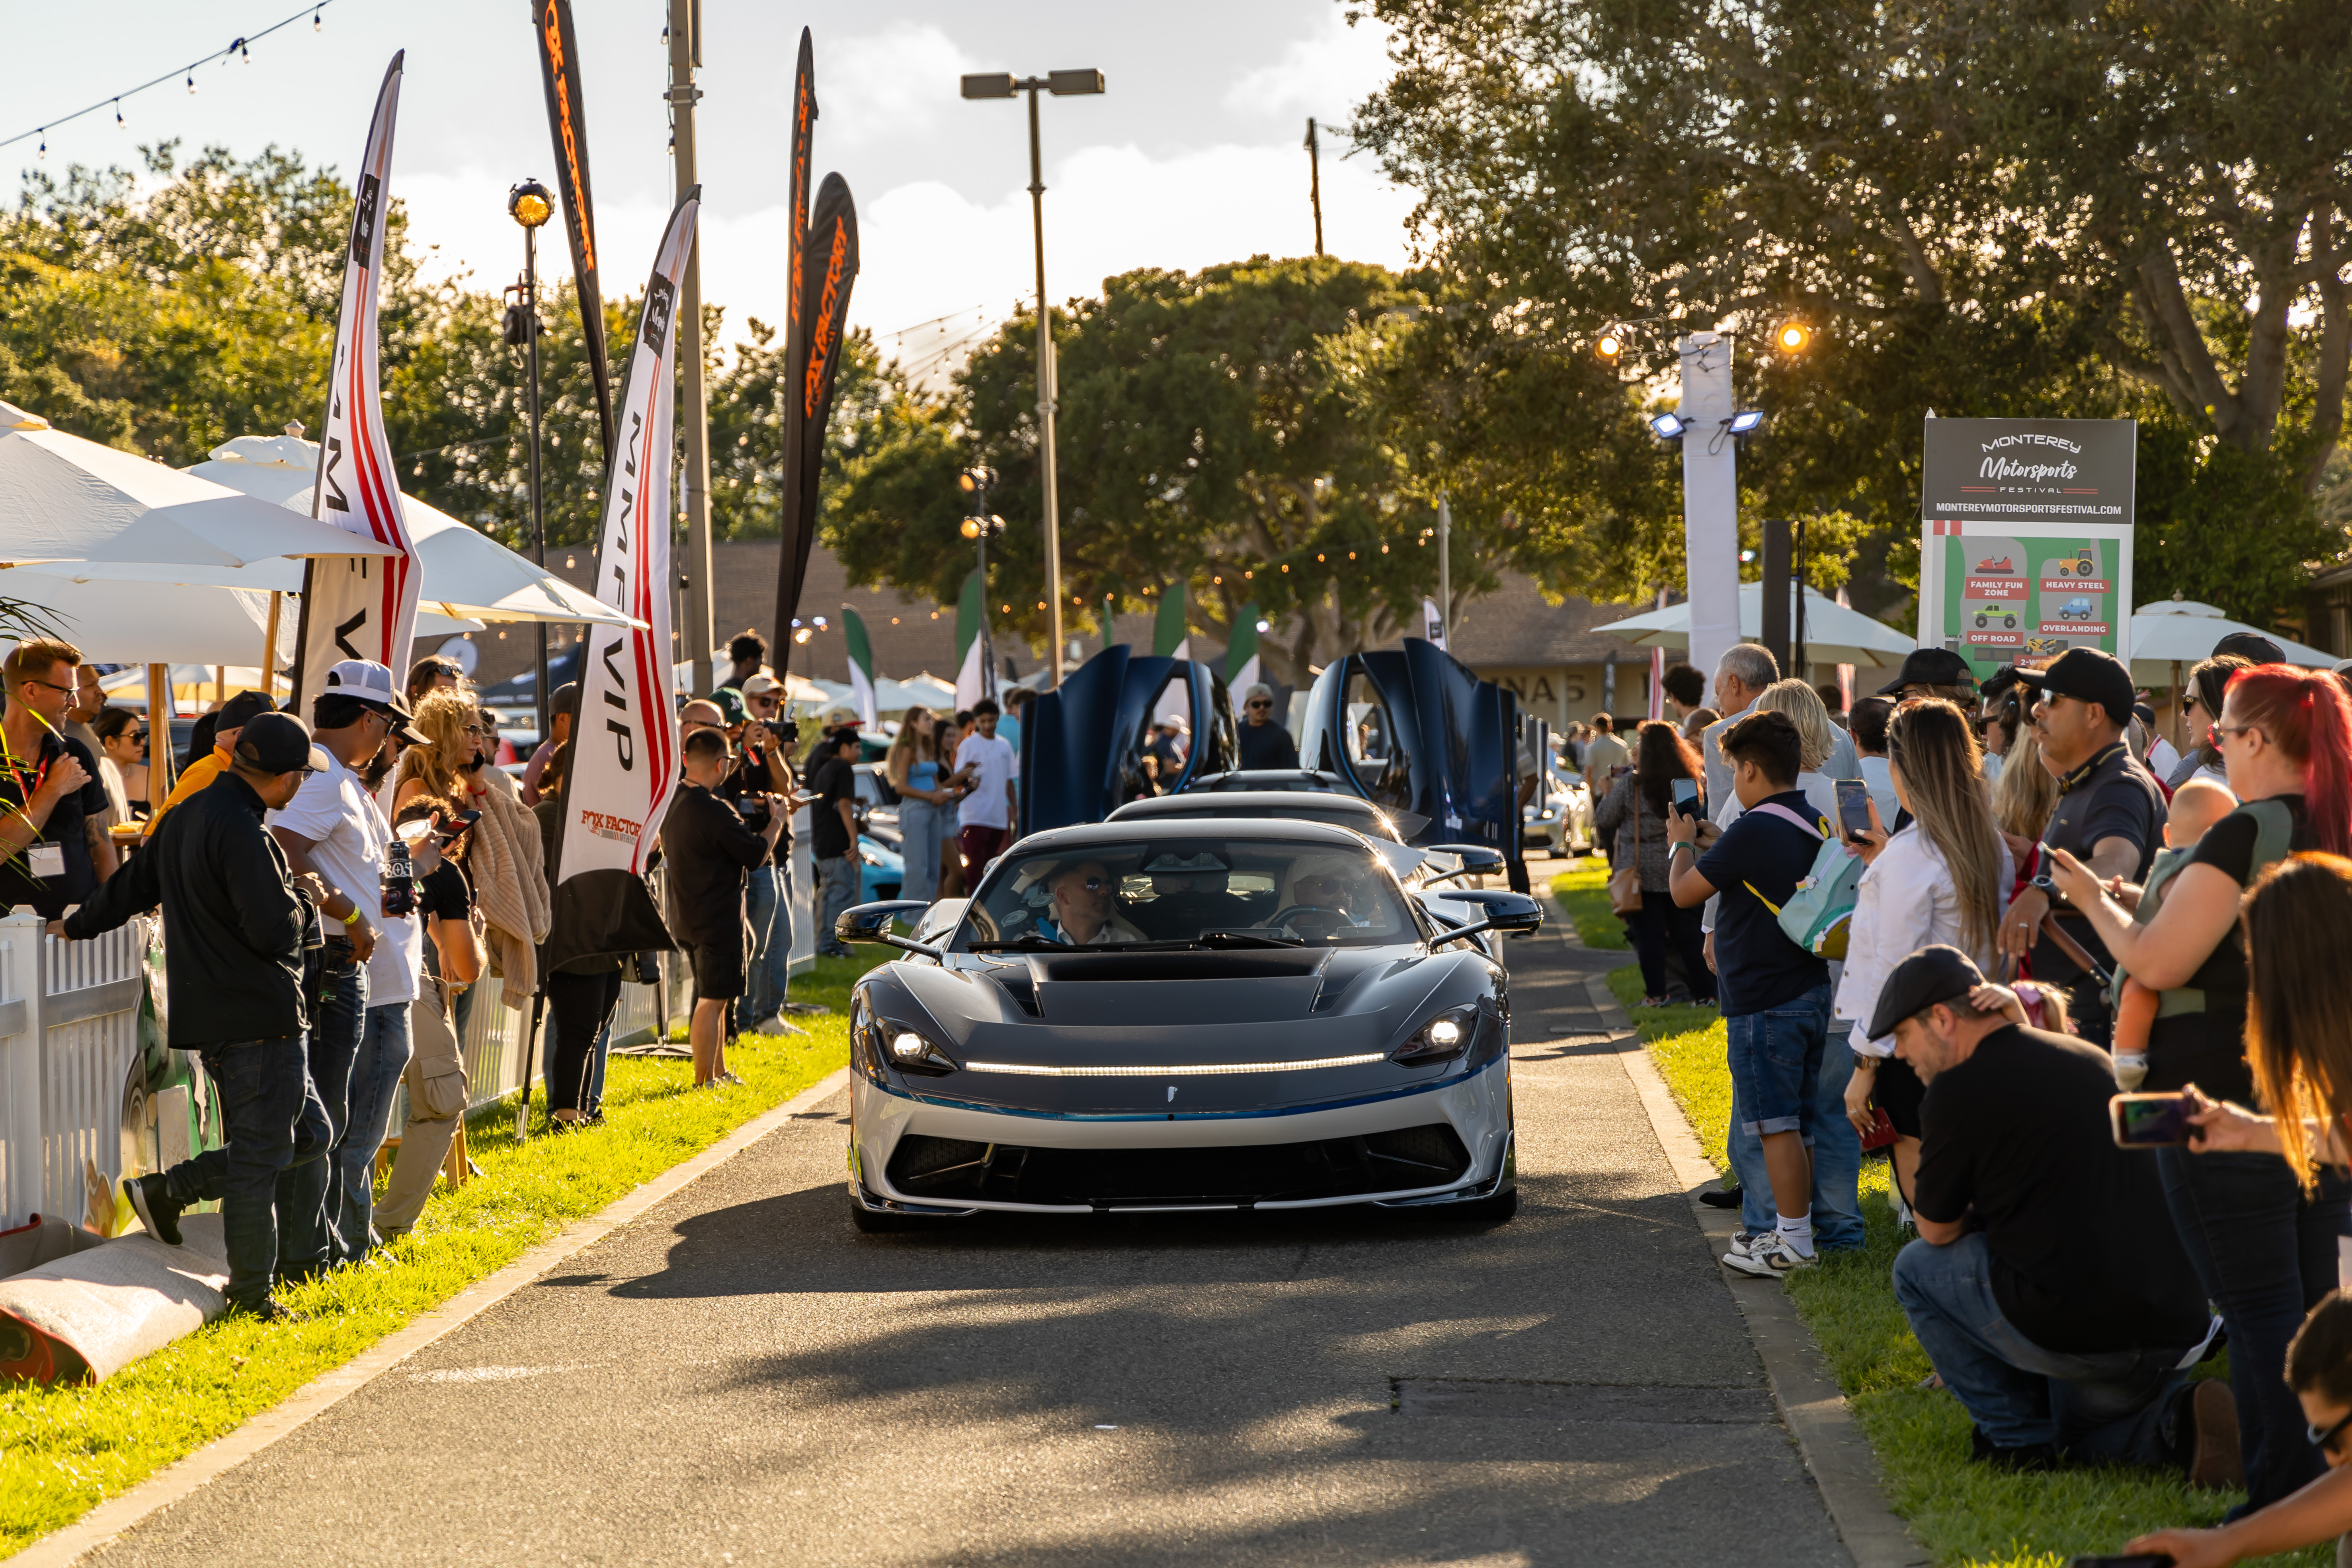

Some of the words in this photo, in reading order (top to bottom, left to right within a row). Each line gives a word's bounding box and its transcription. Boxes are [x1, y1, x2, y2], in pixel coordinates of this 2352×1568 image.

[814, 215, 847, 357] FACTORY
[806, 346, 825, 419] FOX
[1981, 434, 2082, 453] MONTEREY
[1979, 457, 2078, 482] Motorsports
[1936, 502, 2122, 515] MONTEREYMOTORSPORTSFESTIVAL.COM
[1970, 581, 2002, 589] FAMILY
[2042, 624, 2106, 633] OVERLANDING
[603, 637, 633, 772] VIP
[581, 809, 604, 836] FOX
[385, 862, 410, 878] 805
